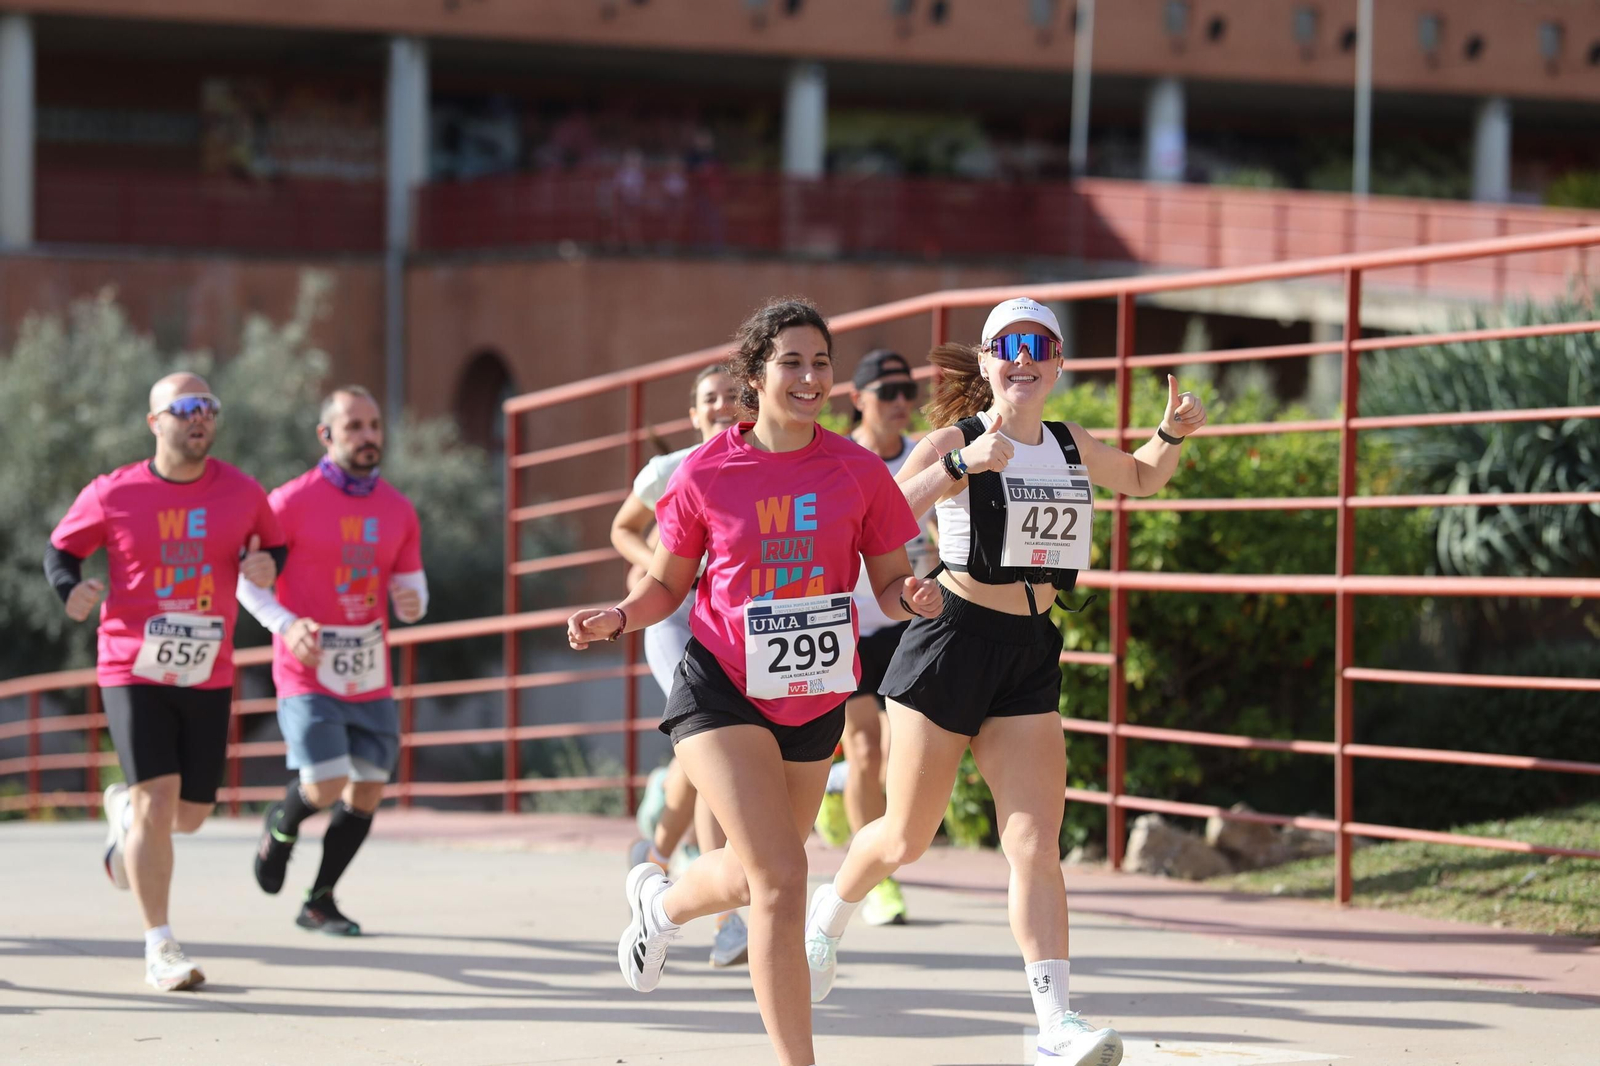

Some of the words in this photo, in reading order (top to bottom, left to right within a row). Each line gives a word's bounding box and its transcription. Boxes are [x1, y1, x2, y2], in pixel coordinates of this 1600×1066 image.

[1010, 487, 1050, 500] UMA
[157, 507, 207, 540] WE
[755, 492, 817, 534] WE
[1021, 506, 1078, 541] 422
[340, 515, 379, 543] WE
[764, 537, 812, 561] RUN
[1032, 552, 1046, 562] WE
[154, 564, 215, 598] UMA
[335, 567, 380, 594] UMA
[751, 566, 825, 601] UMA
[150, 623, 188, 638] UMA
[751, 616, 800, 632] UMA
[156, 640, 211, 666] 656
[333, 649, 375, 676] 681
[767, 630, 840, 674] 299
[789, 683, 808, 693] WE
[1096, 1043, 1117, 1066] KIP
